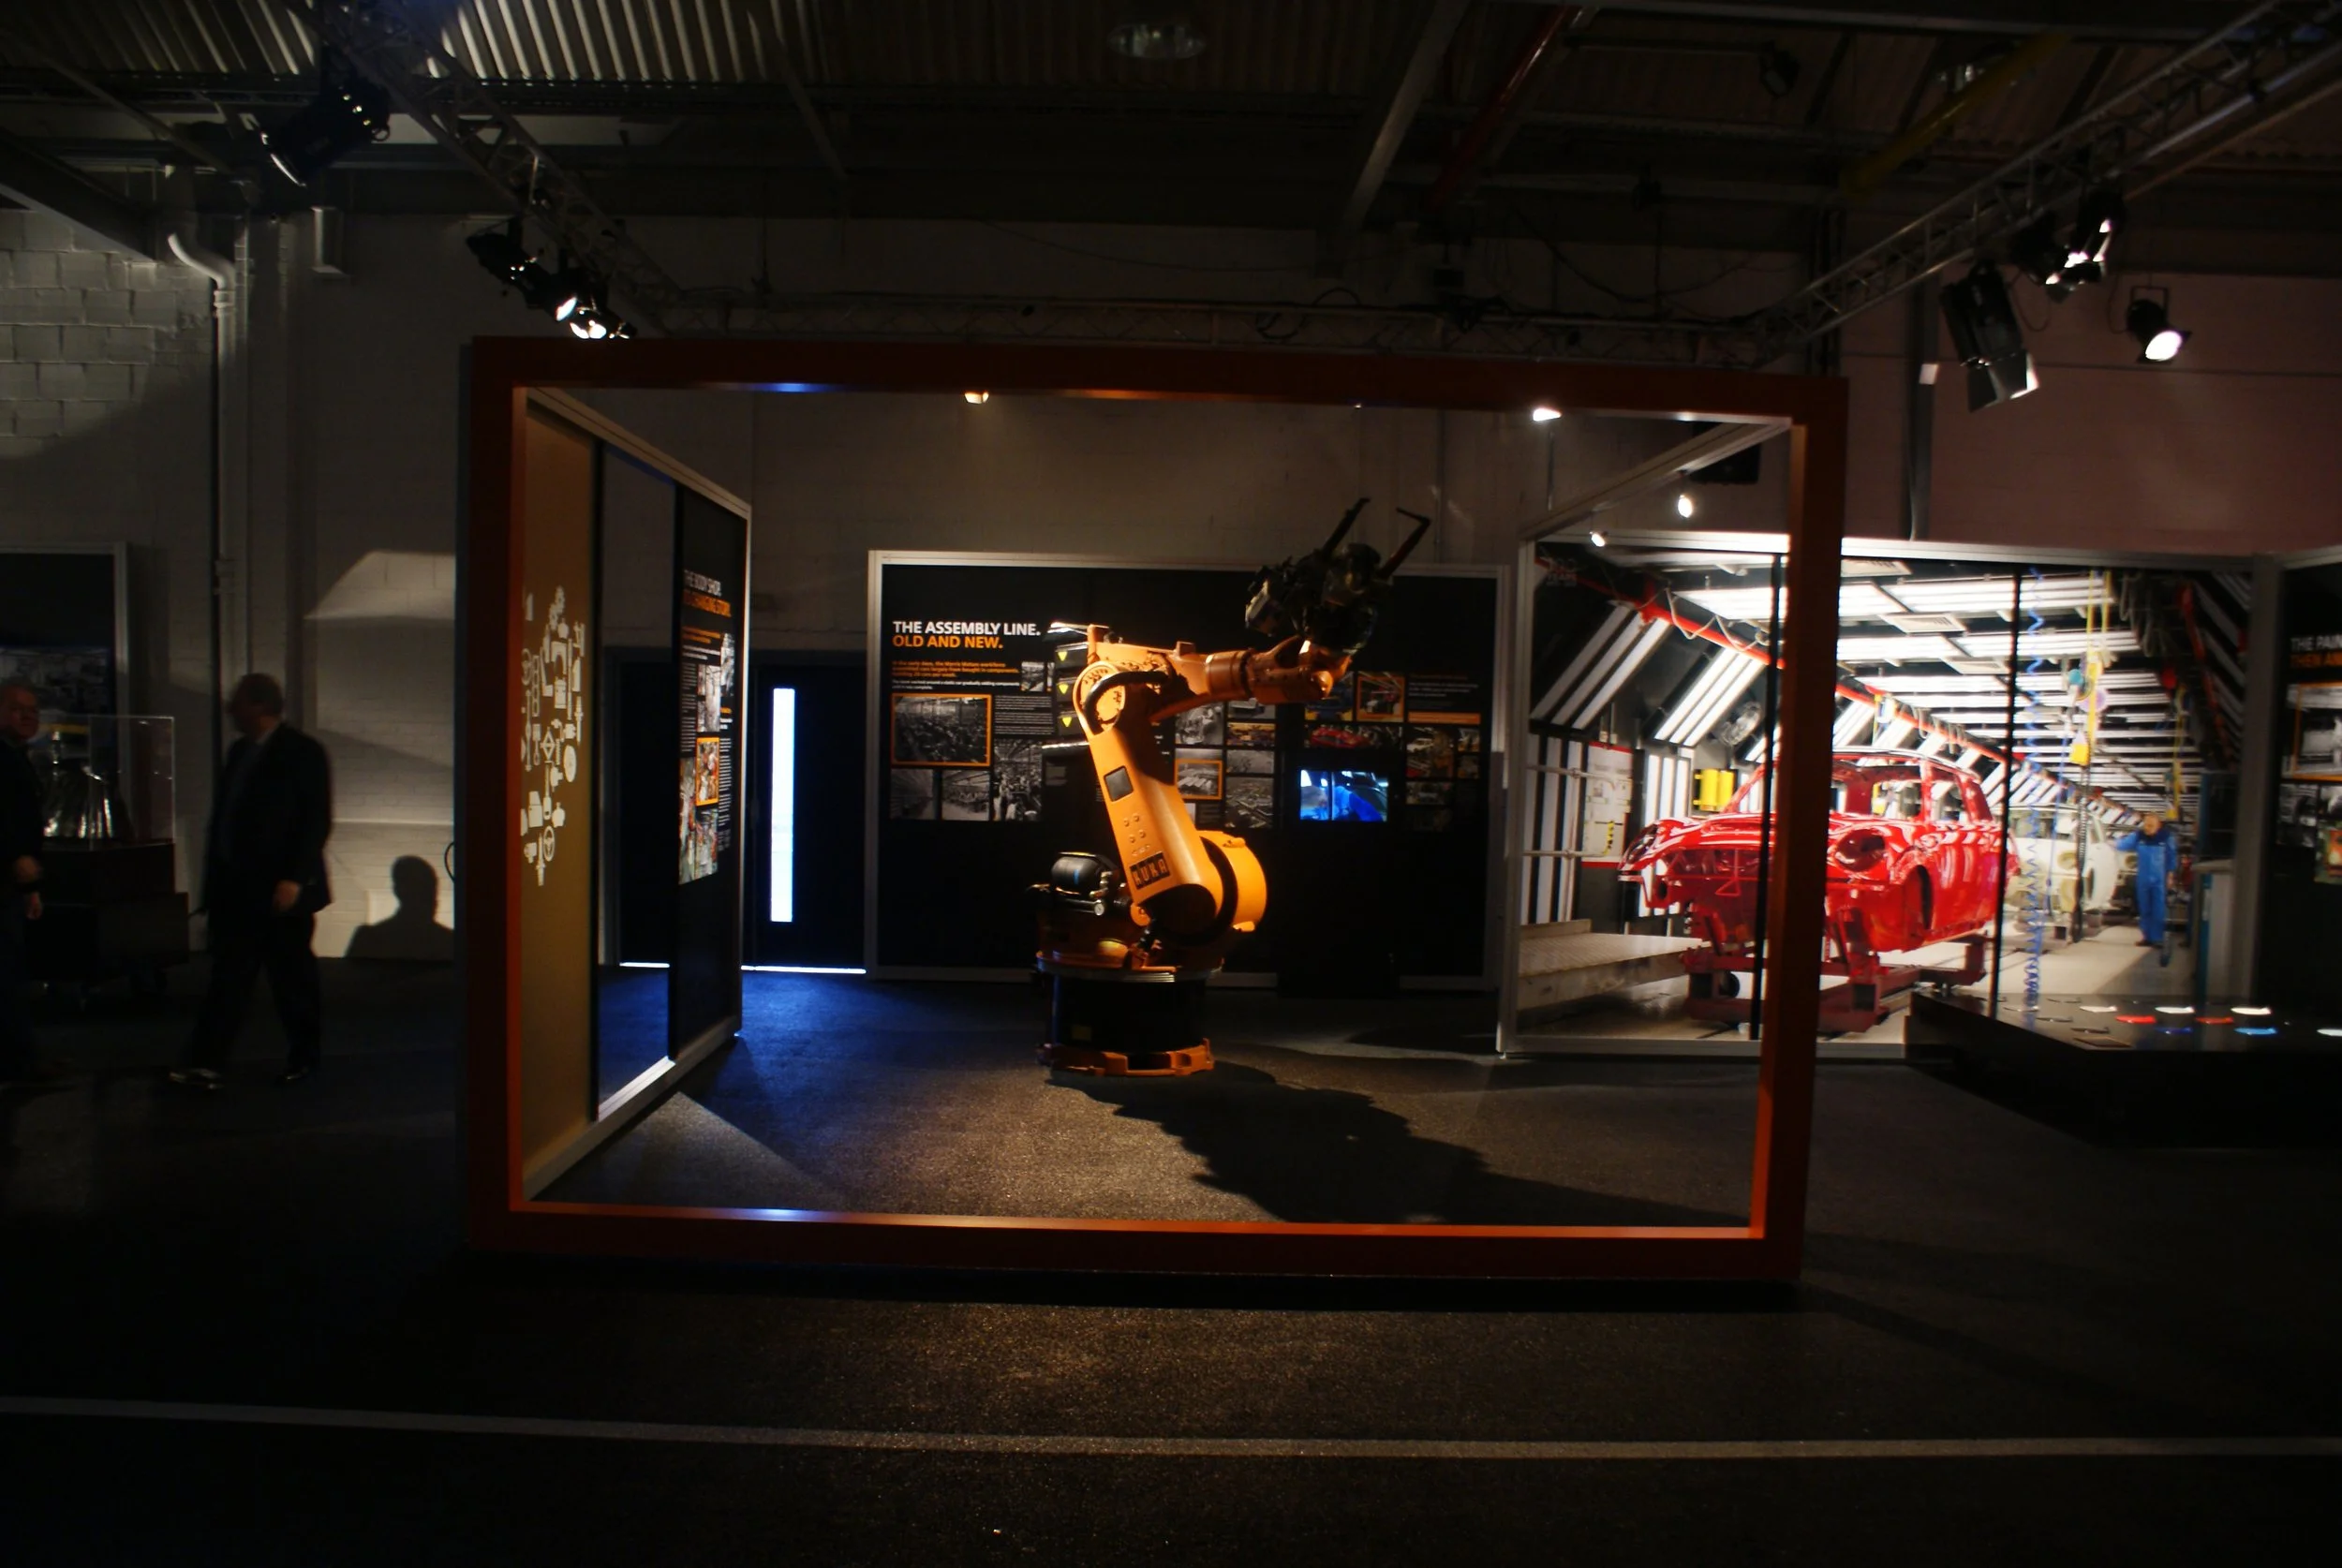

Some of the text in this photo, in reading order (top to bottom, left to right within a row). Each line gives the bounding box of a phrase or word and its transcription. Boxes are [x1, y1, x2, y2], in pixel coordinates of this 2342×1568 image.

[893, 620, 1041, 636] THE ASSEMBLY LINE.
[892, 635, 1004, 649] OLD AND NEW.
[1132, 858, 1167, 885] KUKA
